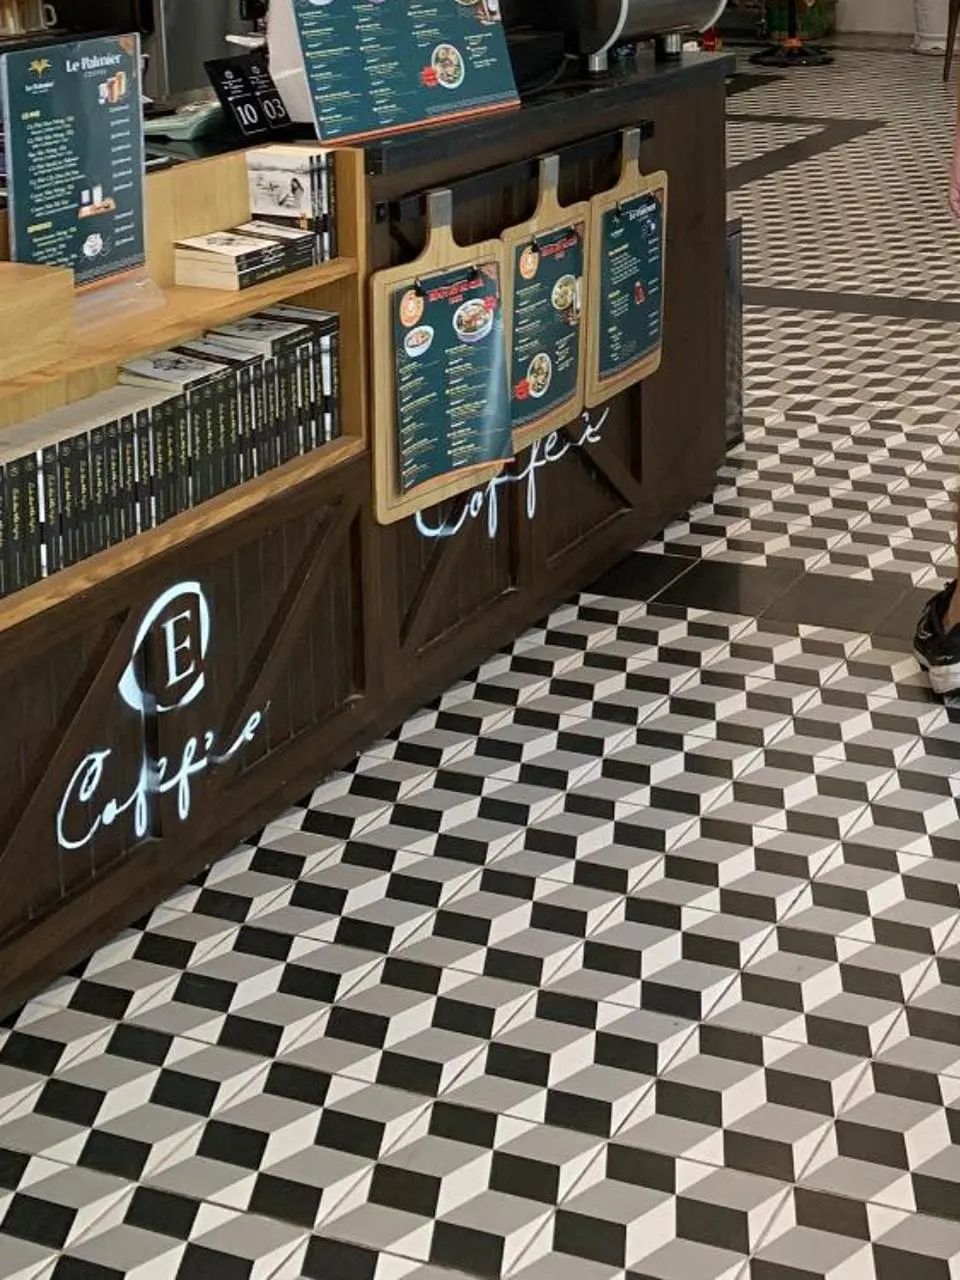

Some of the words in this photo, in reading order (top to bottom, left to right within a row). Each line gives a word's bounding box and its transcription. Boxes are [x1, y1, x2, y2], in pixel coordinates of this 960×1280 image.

[66, 59, 80, 73] Le
[236, 103, 258, 125] 10
[263, 98, 286, 120] 03
